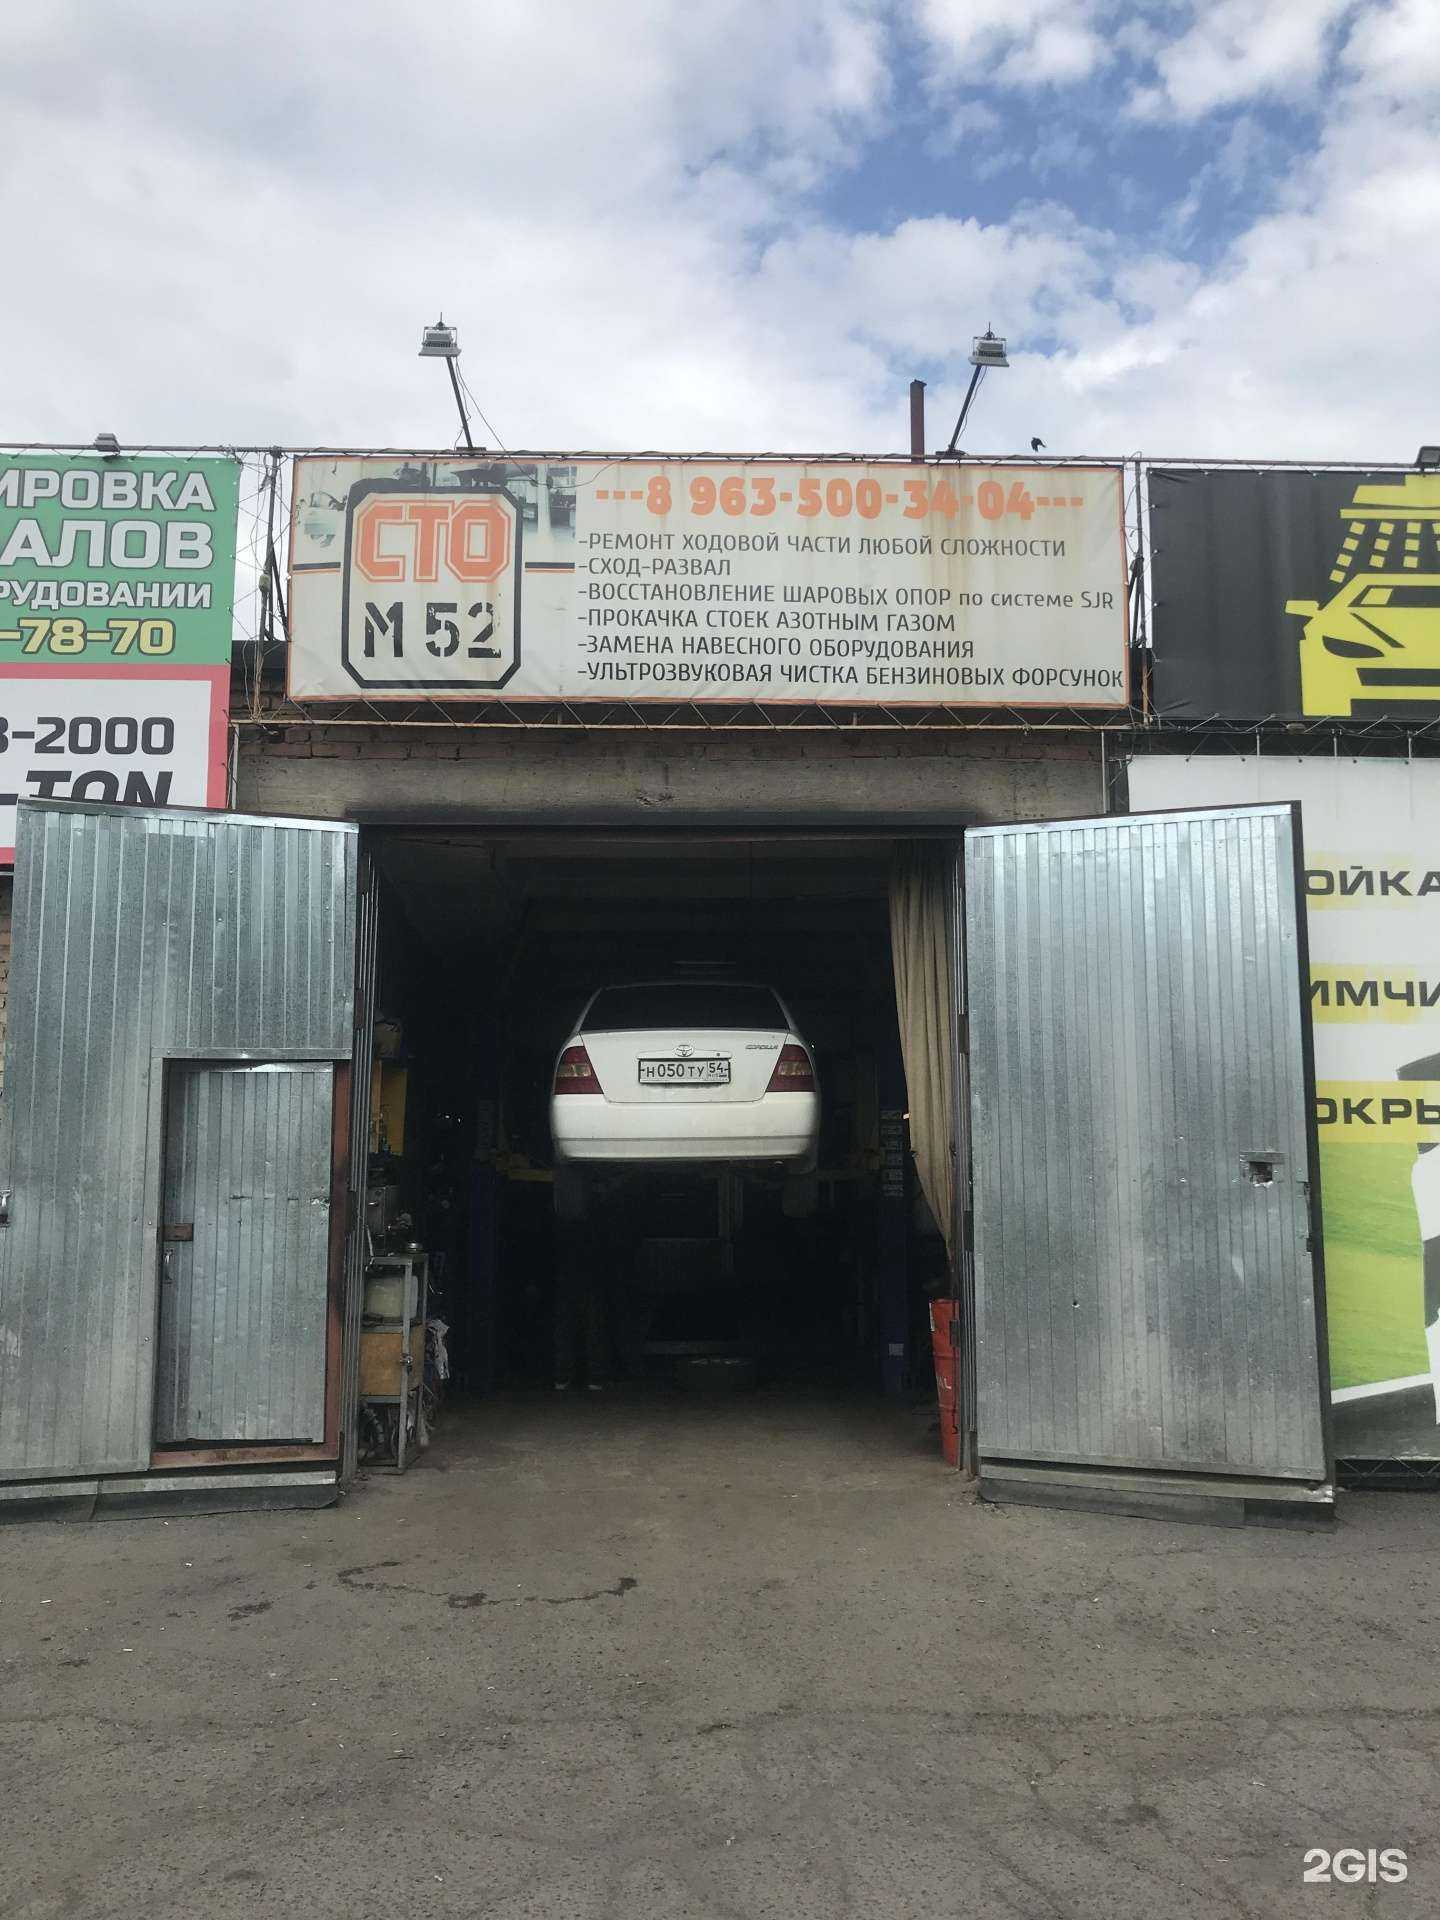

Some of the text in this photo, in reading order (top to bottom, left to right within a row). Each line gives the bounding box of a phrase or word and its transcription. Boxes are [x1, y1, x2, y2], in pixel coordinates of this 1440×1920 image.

[0, 519, 214, 569] АЛОВ
[355, 500, 512, 583] СТО
[578, 532, 1066, 557] -РЕМОНТ ХОДОВОЙ ЧАСТИ ЛЮБОЙ СЛОЖНОСТИ
[578, 583, 1113, 609] -ВОССТАНОВЛЕНИЕ ШАРОВЫХ ОПОР по системе SJR
[364, 602, 501, 659] М 52
[577, 609, 955, 632] -ПРОКАЧКА СТОЕК АЗОТНЫМ ГАЗОМ
[577, 635, 974, 662] -ЗАМЕНА НАВЕСНОГО ОБОРУДОВАНИЯ
[781, 665, 858, 684] ЧИСТКА
[866, 667, 1004, 686] БЕНЗИНОВЫХ
[1012, 668, 1124, 688] ФОРСУНОК
[0, 716, 175, 755] -2000
[1304, 866, 1440, 896] ОЙКА
